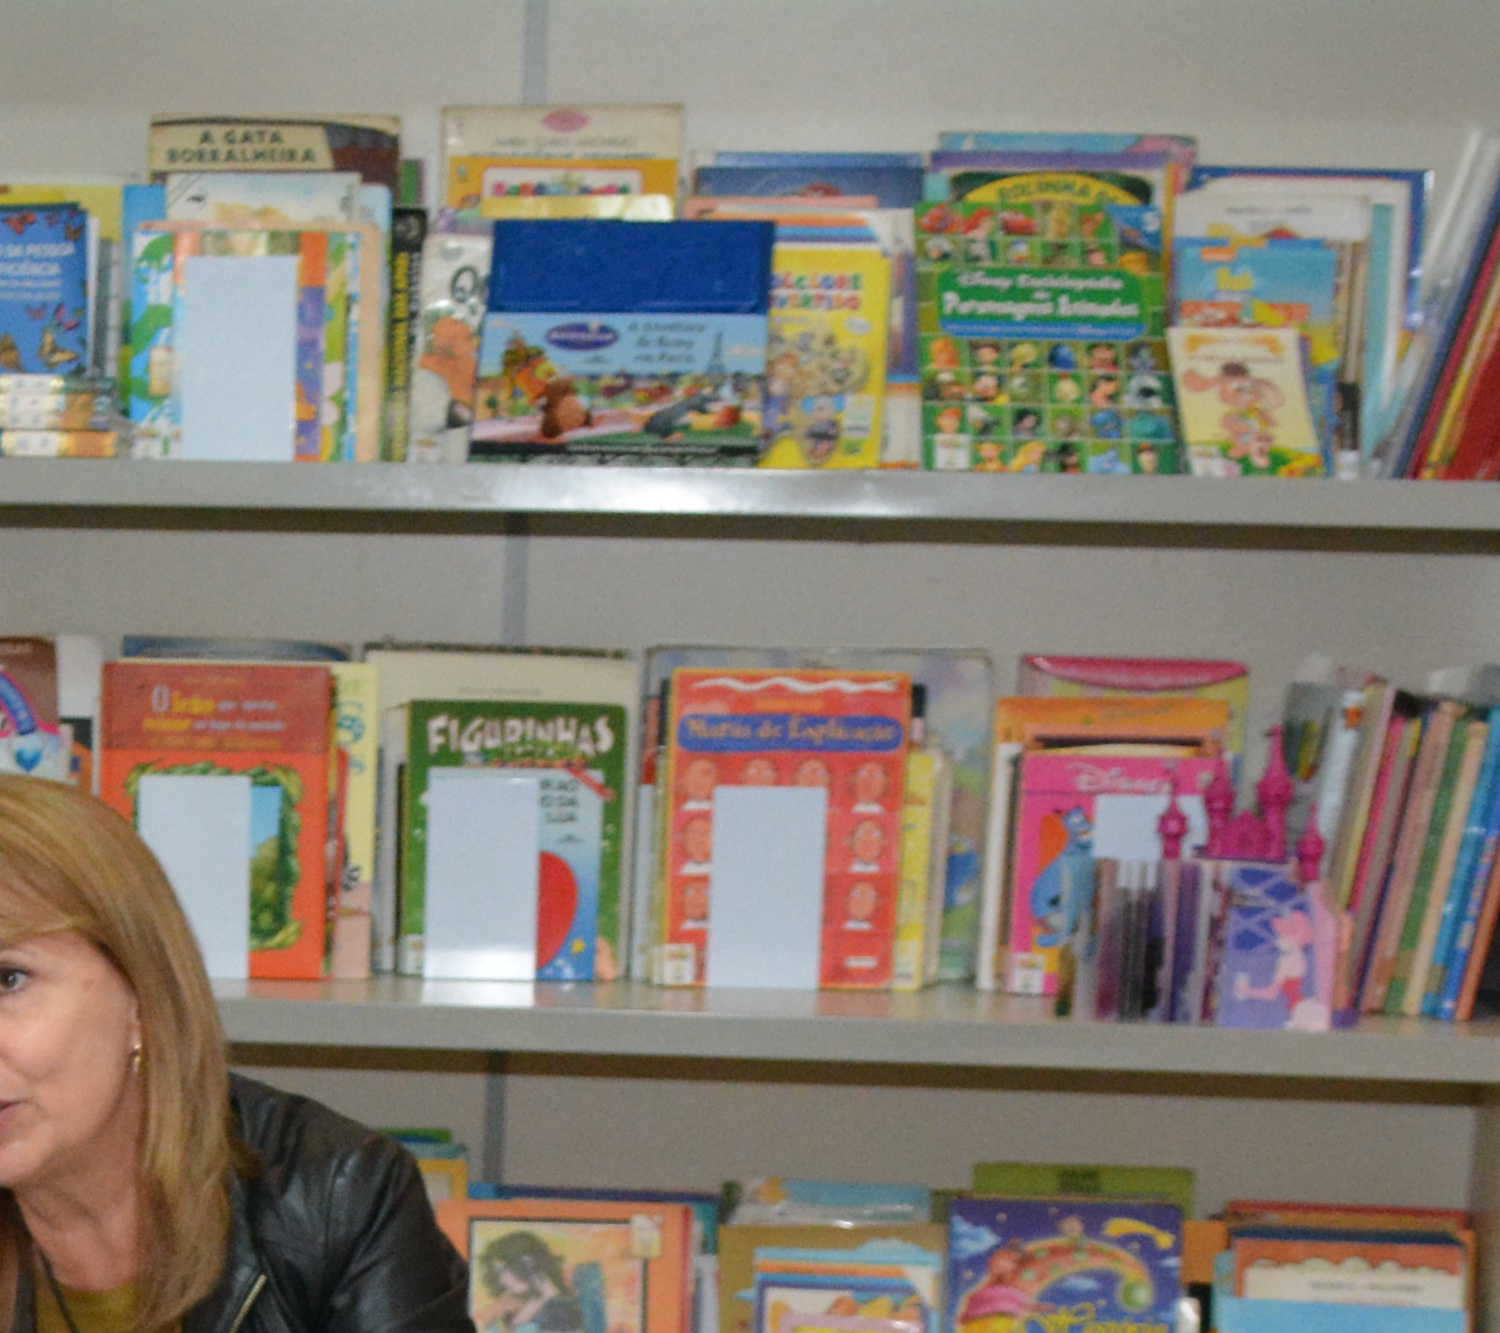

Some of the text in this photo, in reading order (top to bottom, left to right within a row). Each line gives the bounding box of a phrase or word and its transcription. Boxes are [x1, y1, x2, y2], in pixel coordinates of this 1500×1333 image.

[200, 129, 283, 143] A GATA
[166, 148, 317, 162] BORRALHEIRA
[426, 713, 615, 757] FIGURINHAS
